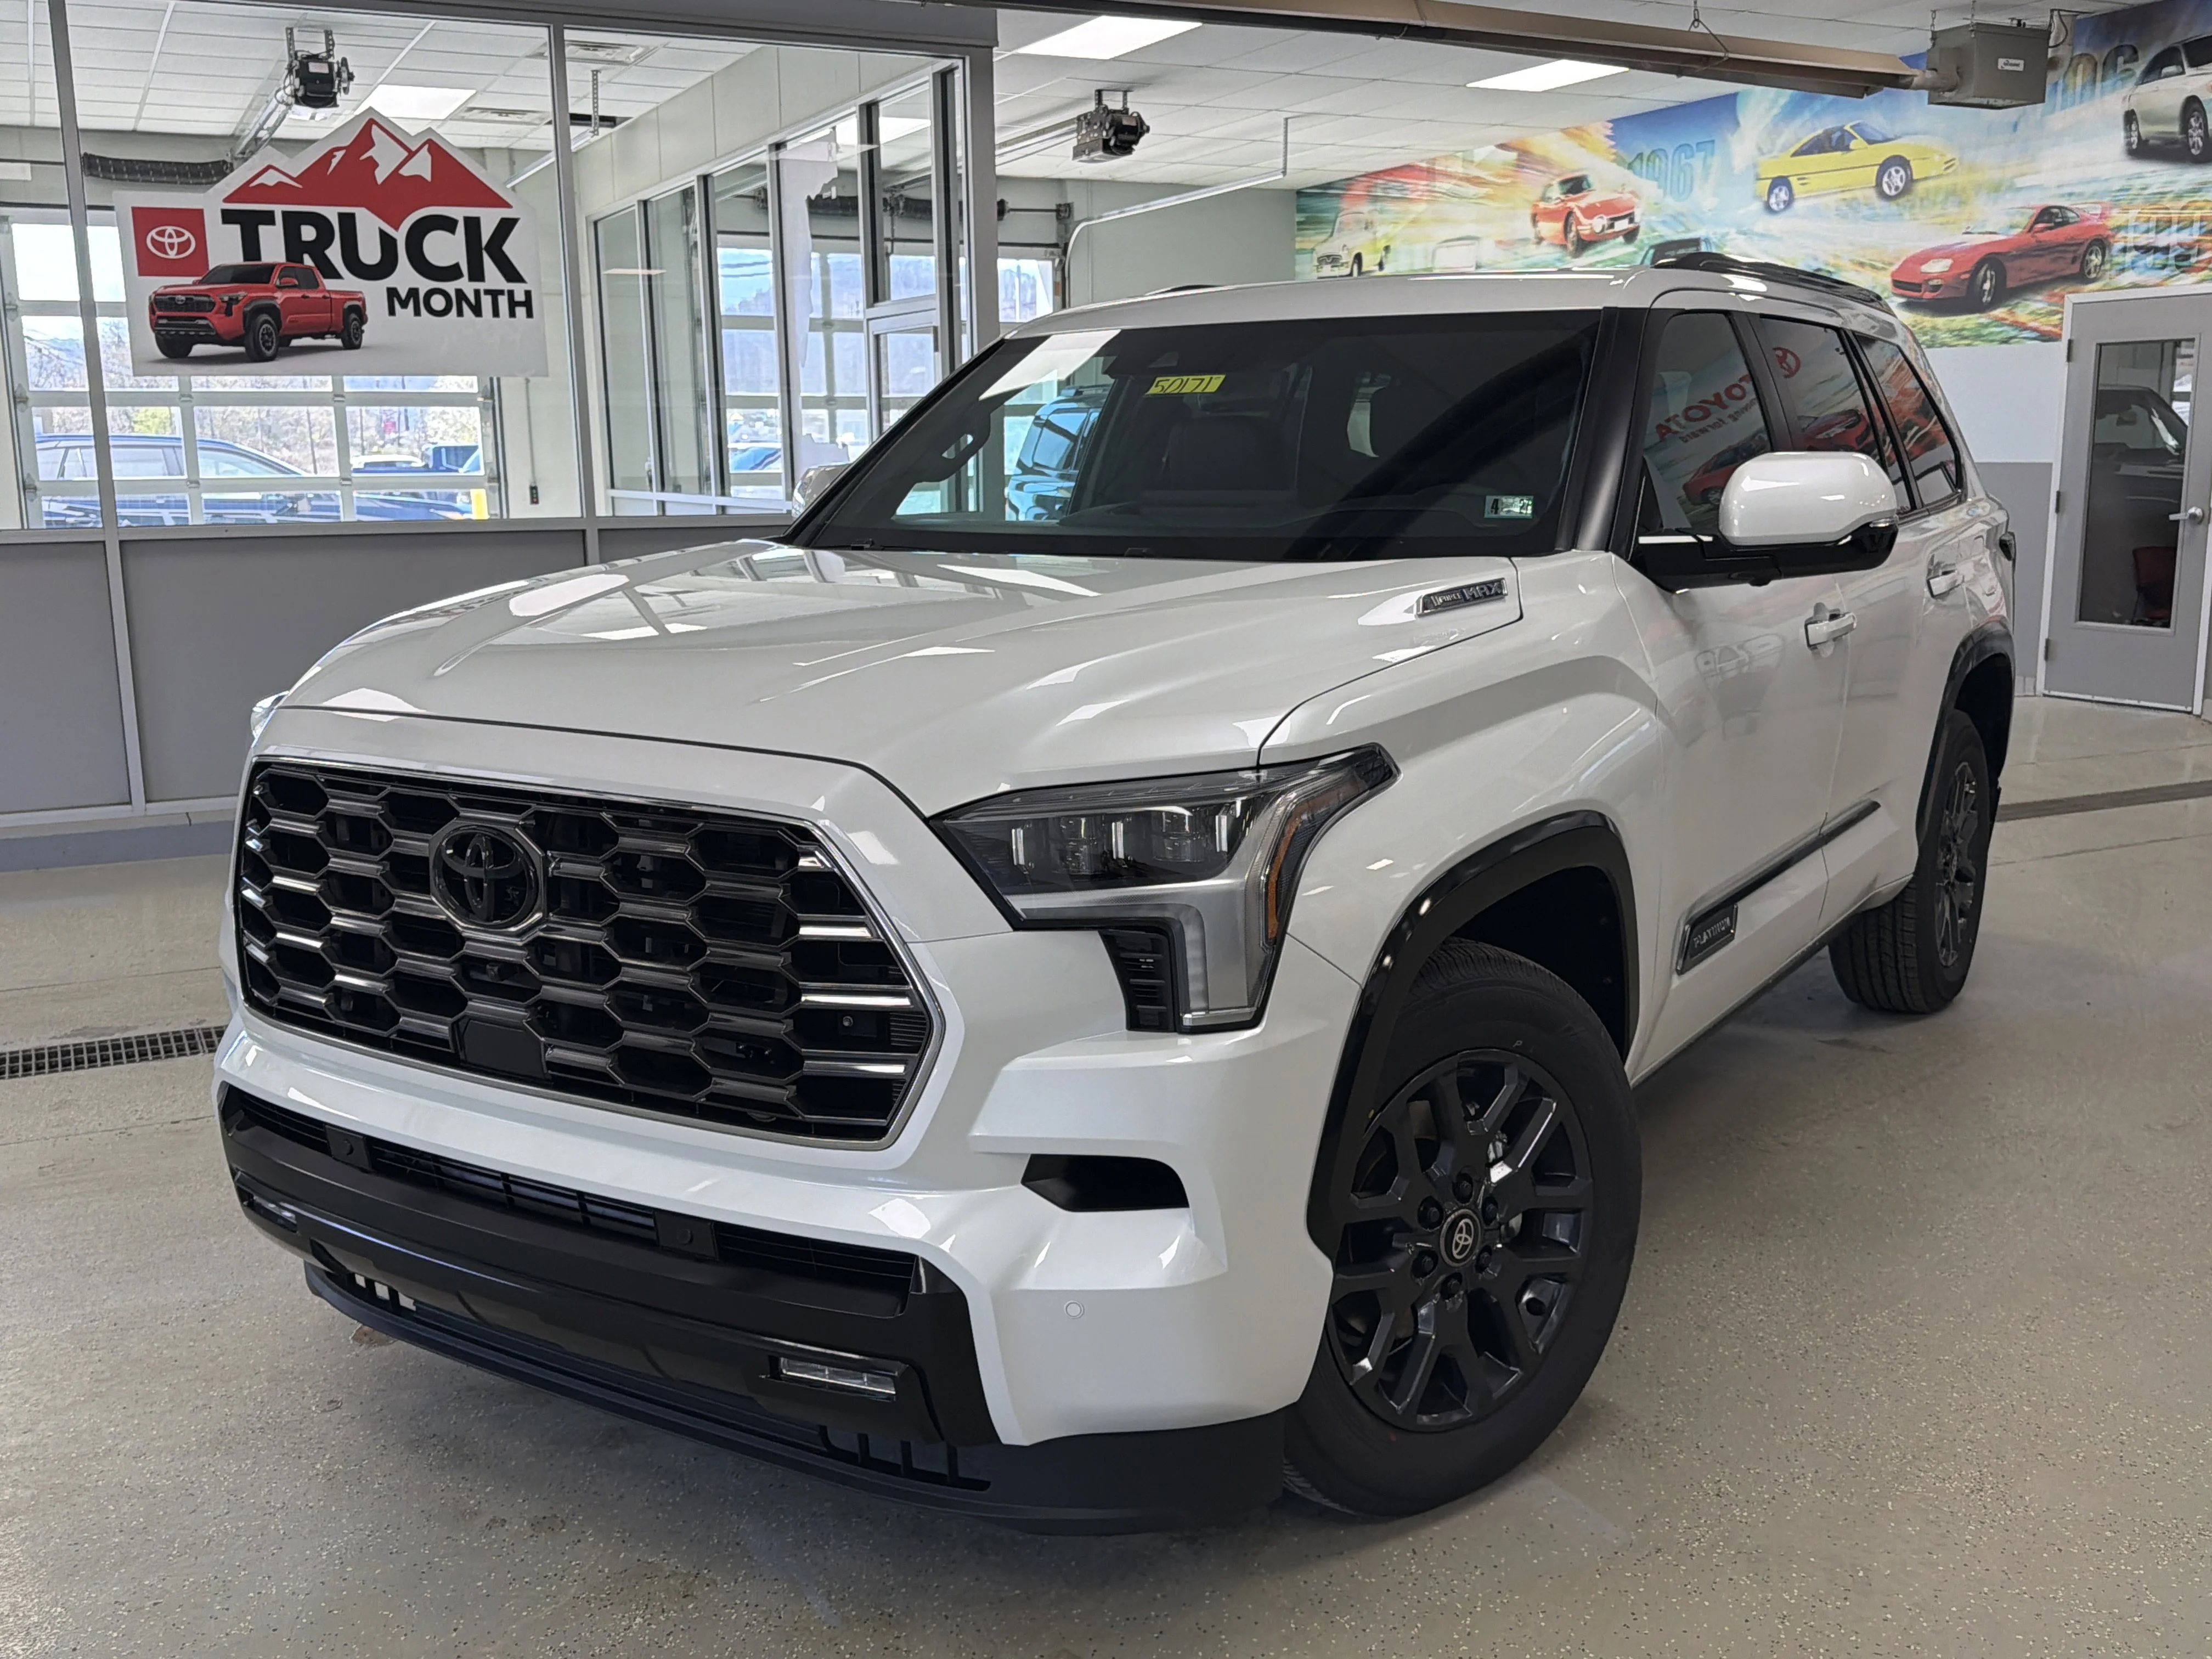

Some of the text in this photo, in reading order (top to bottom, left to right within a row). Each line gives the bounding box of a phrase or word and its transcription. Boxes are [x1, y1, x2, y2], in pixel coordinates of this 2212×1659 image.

[1626, 139, 1716, 202] 1967
[221, 208, 527, 284] TRUCK
[386, 286, 534, 319] MONTH
[1154, 376, 1214, 393] 50171
[1491, 498, 1499, 515] 4
[1462, 582, 1502, 600] MAX
[1693, 916, 1731, 949] PLATINUM
